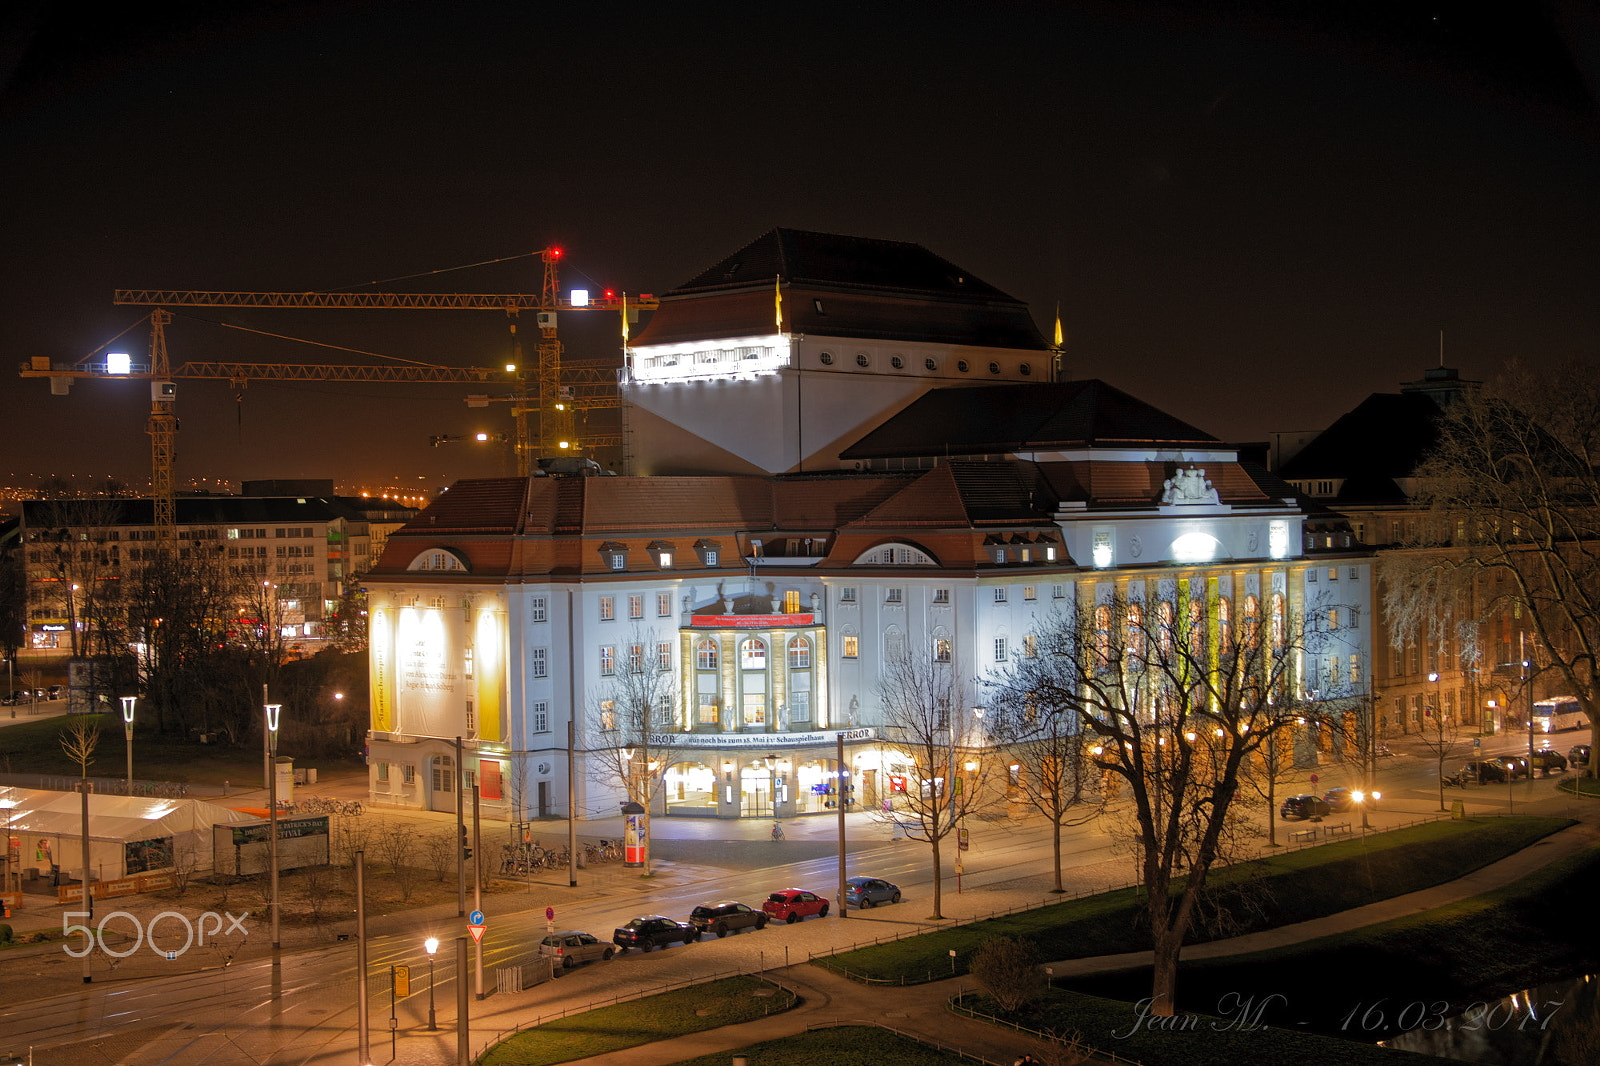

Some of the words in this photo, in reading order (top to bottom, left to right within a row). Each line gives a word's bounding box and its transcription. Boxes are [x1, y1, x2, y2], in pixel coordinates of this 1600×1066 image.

[701, 736, 717, 744] noch
[717, 736, 727, 744] bis
[776, 734, 825, 744] Schauspielhaus
